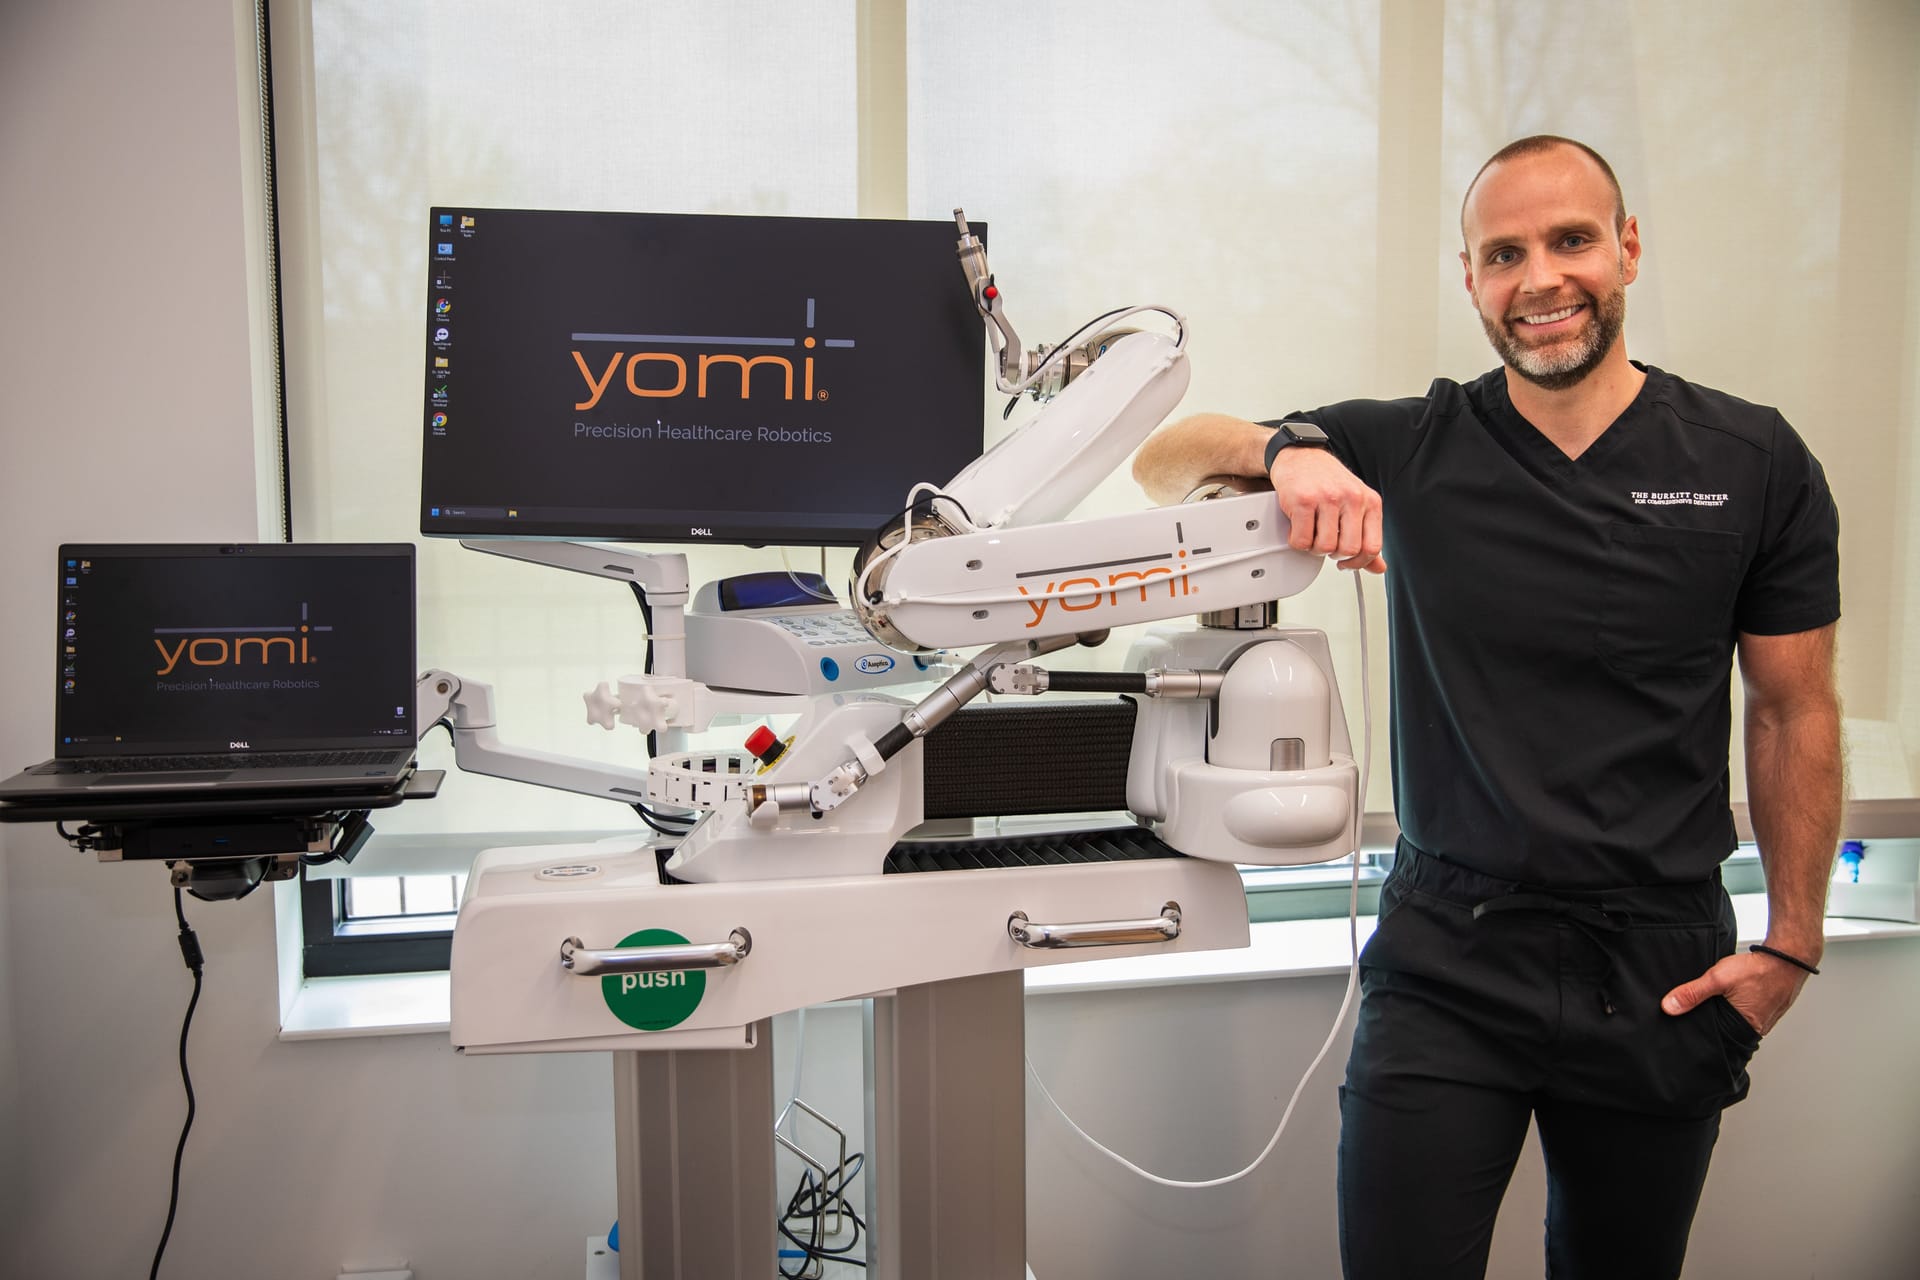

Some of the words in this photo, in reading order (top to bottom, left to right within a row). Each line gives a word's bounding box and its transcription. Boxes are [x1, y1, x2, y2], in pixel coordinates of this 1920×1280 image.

[574, 422, 652, 438] Precision
[657, 424, 752, 441] Healthcare
[757, 426, 832, 443] Robotics
[1631, 491, 1649, 499] THE
[1651, 491, 1690, 499] BURKITT
[691, 527, 713, 536] DELL
[156, 680, 208, 692] Precision
[210, 679, 270, 690] Healthcare
[272, 679, 321, 690] Robotics
[230, 741, 249, 749] DELL
